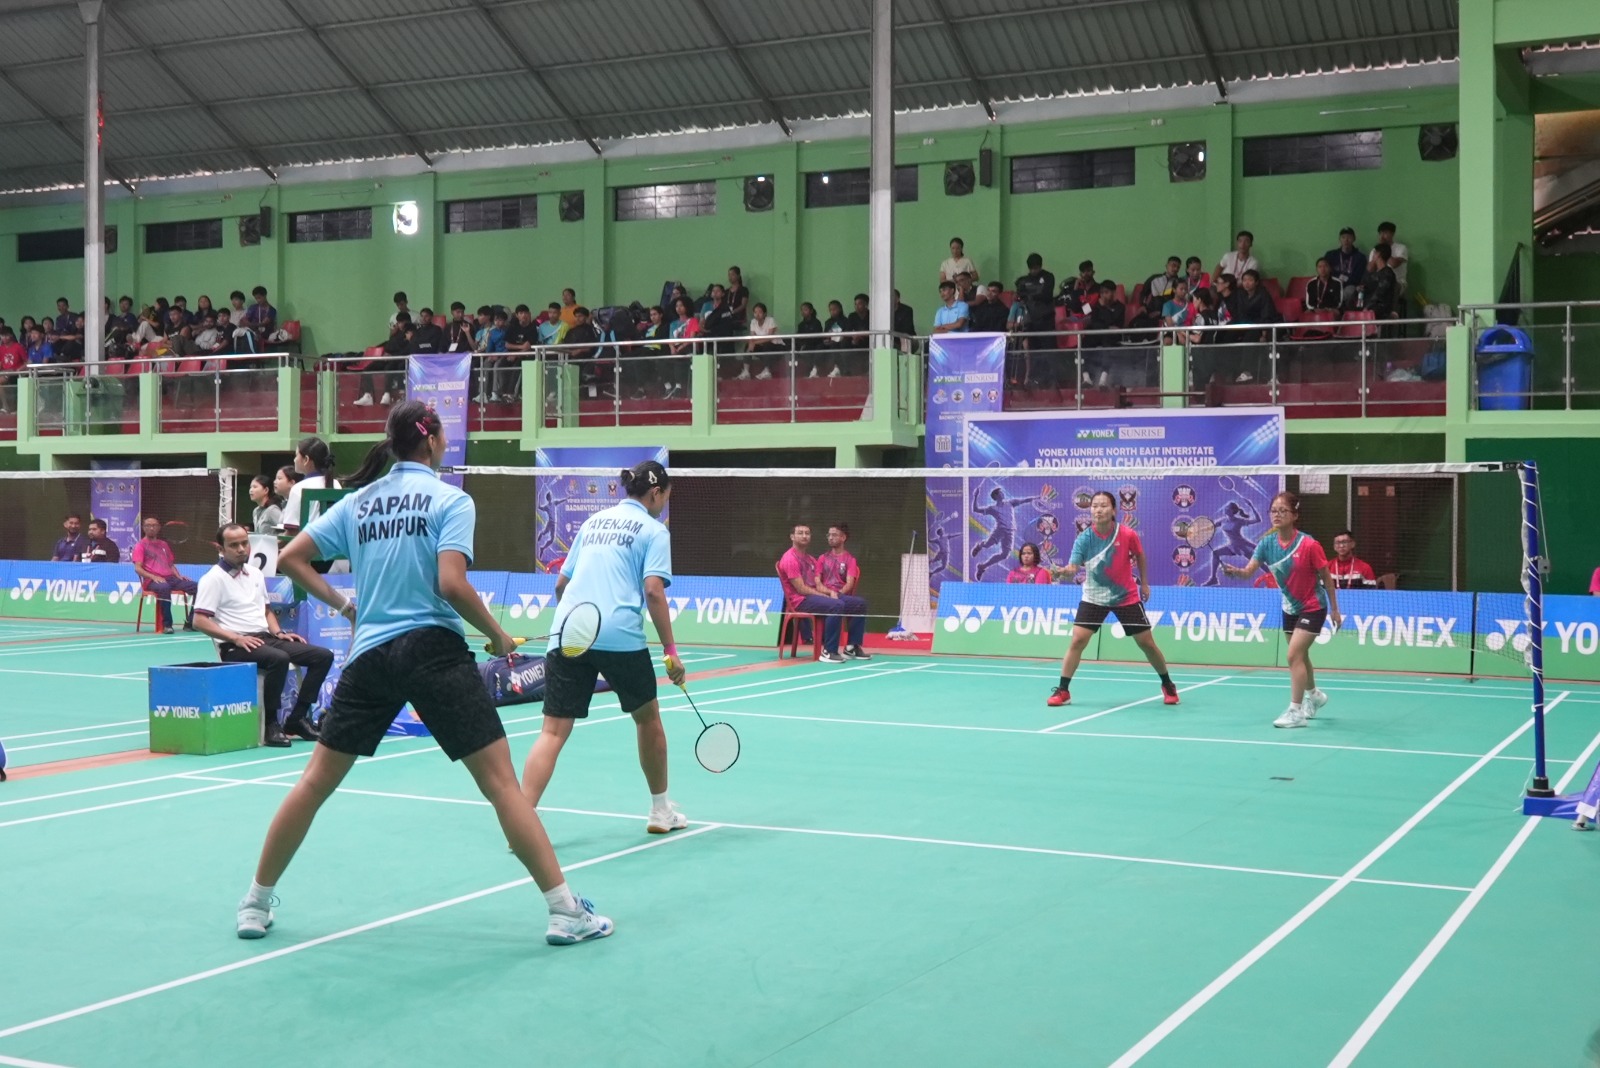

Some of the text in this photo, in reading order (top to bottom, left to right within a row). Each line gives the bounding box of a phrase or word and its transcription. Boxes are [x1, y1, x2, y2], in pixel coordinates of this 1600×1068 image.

[1091, 428, 1164, 438] YONEX SUNRISE
[1038, 446, 1215, 457] YONEX SUNRISE NORTH EAST INTERSTATE
[1034, 457, 1113, 468] BADMINTON
[357, 492, 432, 520] SAPAM
[357, 516, 429, 546] MANIPUR
[582, 532, 635, 550] MANIPUR
[45, 579, 99, 603] YONEX
[694, 597, 772, 625] YONEX
[1170, 611, 1266, 643] YONEX
[1354, 614, 1457, 648] YONEX
[170, 706, 201, 719] YONEX
[226, 701, 253, 716] YONEX
